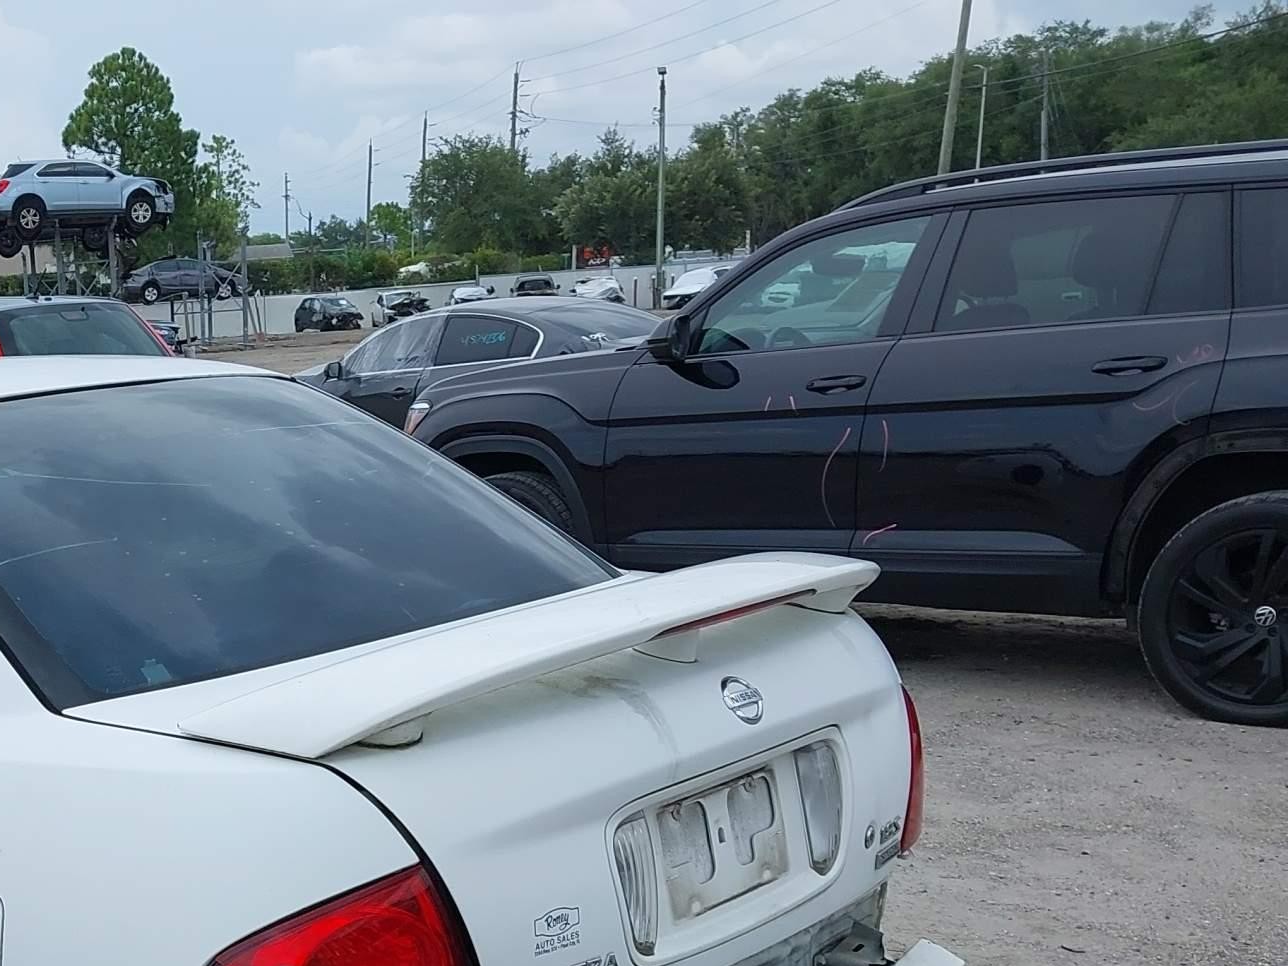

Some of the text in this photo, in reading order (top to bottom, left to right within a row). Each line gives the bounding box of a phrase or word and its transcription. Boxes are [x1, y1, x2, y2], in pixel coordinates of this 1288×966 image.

[730, 688, 761, 704] NISSAN
[535, 938, 555, 951] AUTO
[556, 930, 580, 944] SALES
